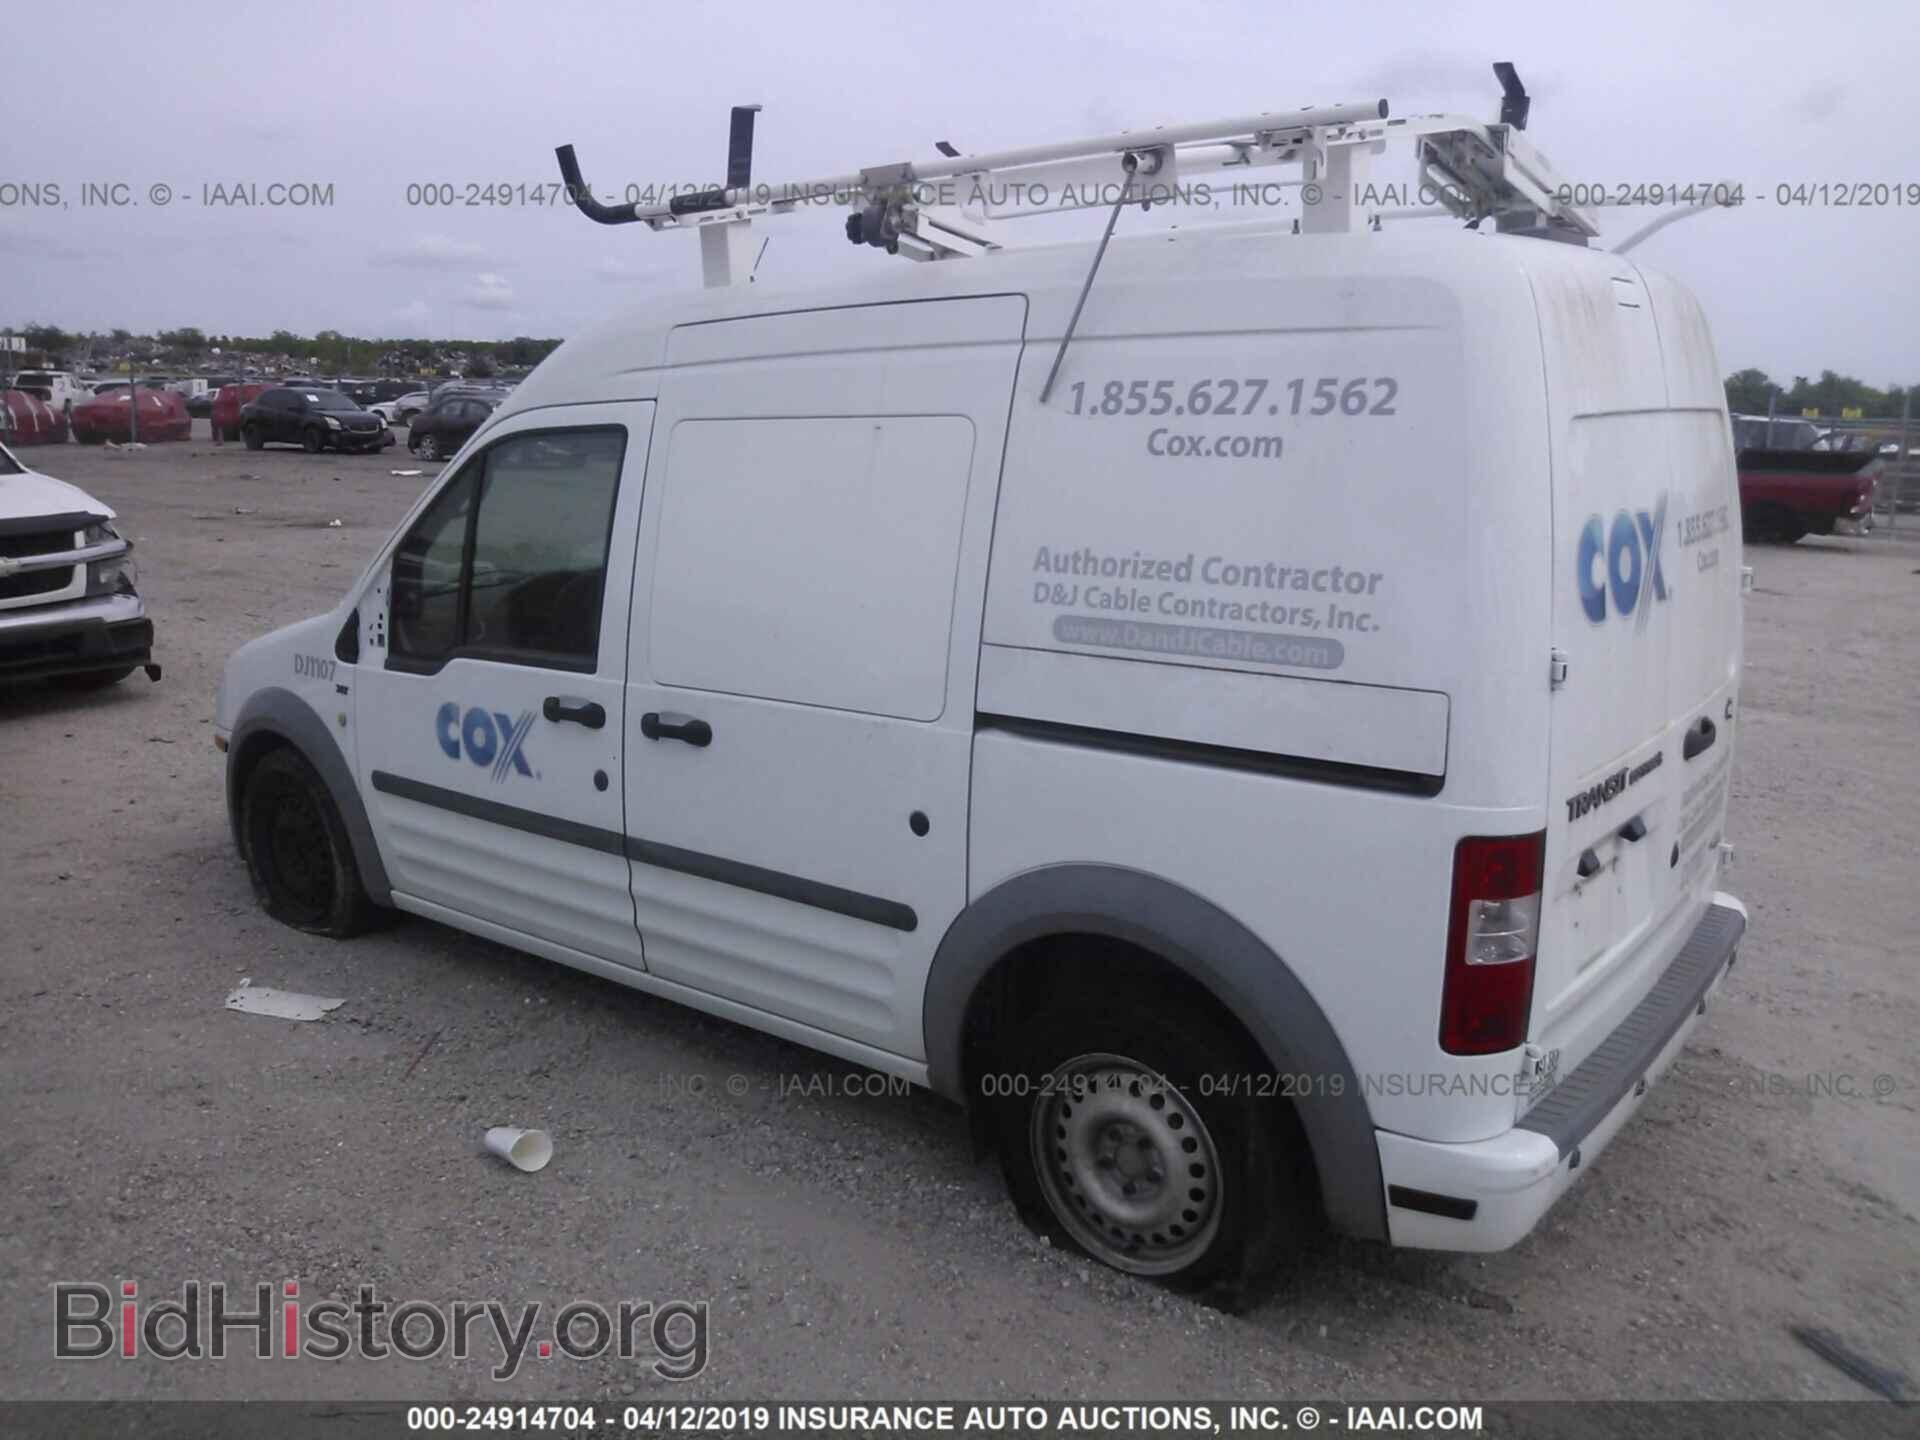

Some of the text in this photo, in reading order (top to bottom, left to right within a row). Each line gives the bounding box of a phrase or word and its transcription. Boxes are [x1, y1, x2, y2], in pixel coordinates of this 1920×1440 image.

[1068, 377, 1398, 416] 1.855.627.1562
[1147, 428, 1284, 458] Cox.com
[1033, 546, 1384, 596] Authorized Contractor
[1577, 492, 1668, 636] COX
[1033, 581, 1380, 632] D&J Cable Contractors, Inc.
[294, 654, 337, 681] DJ1107
[436, 701, 538, 784] COX
